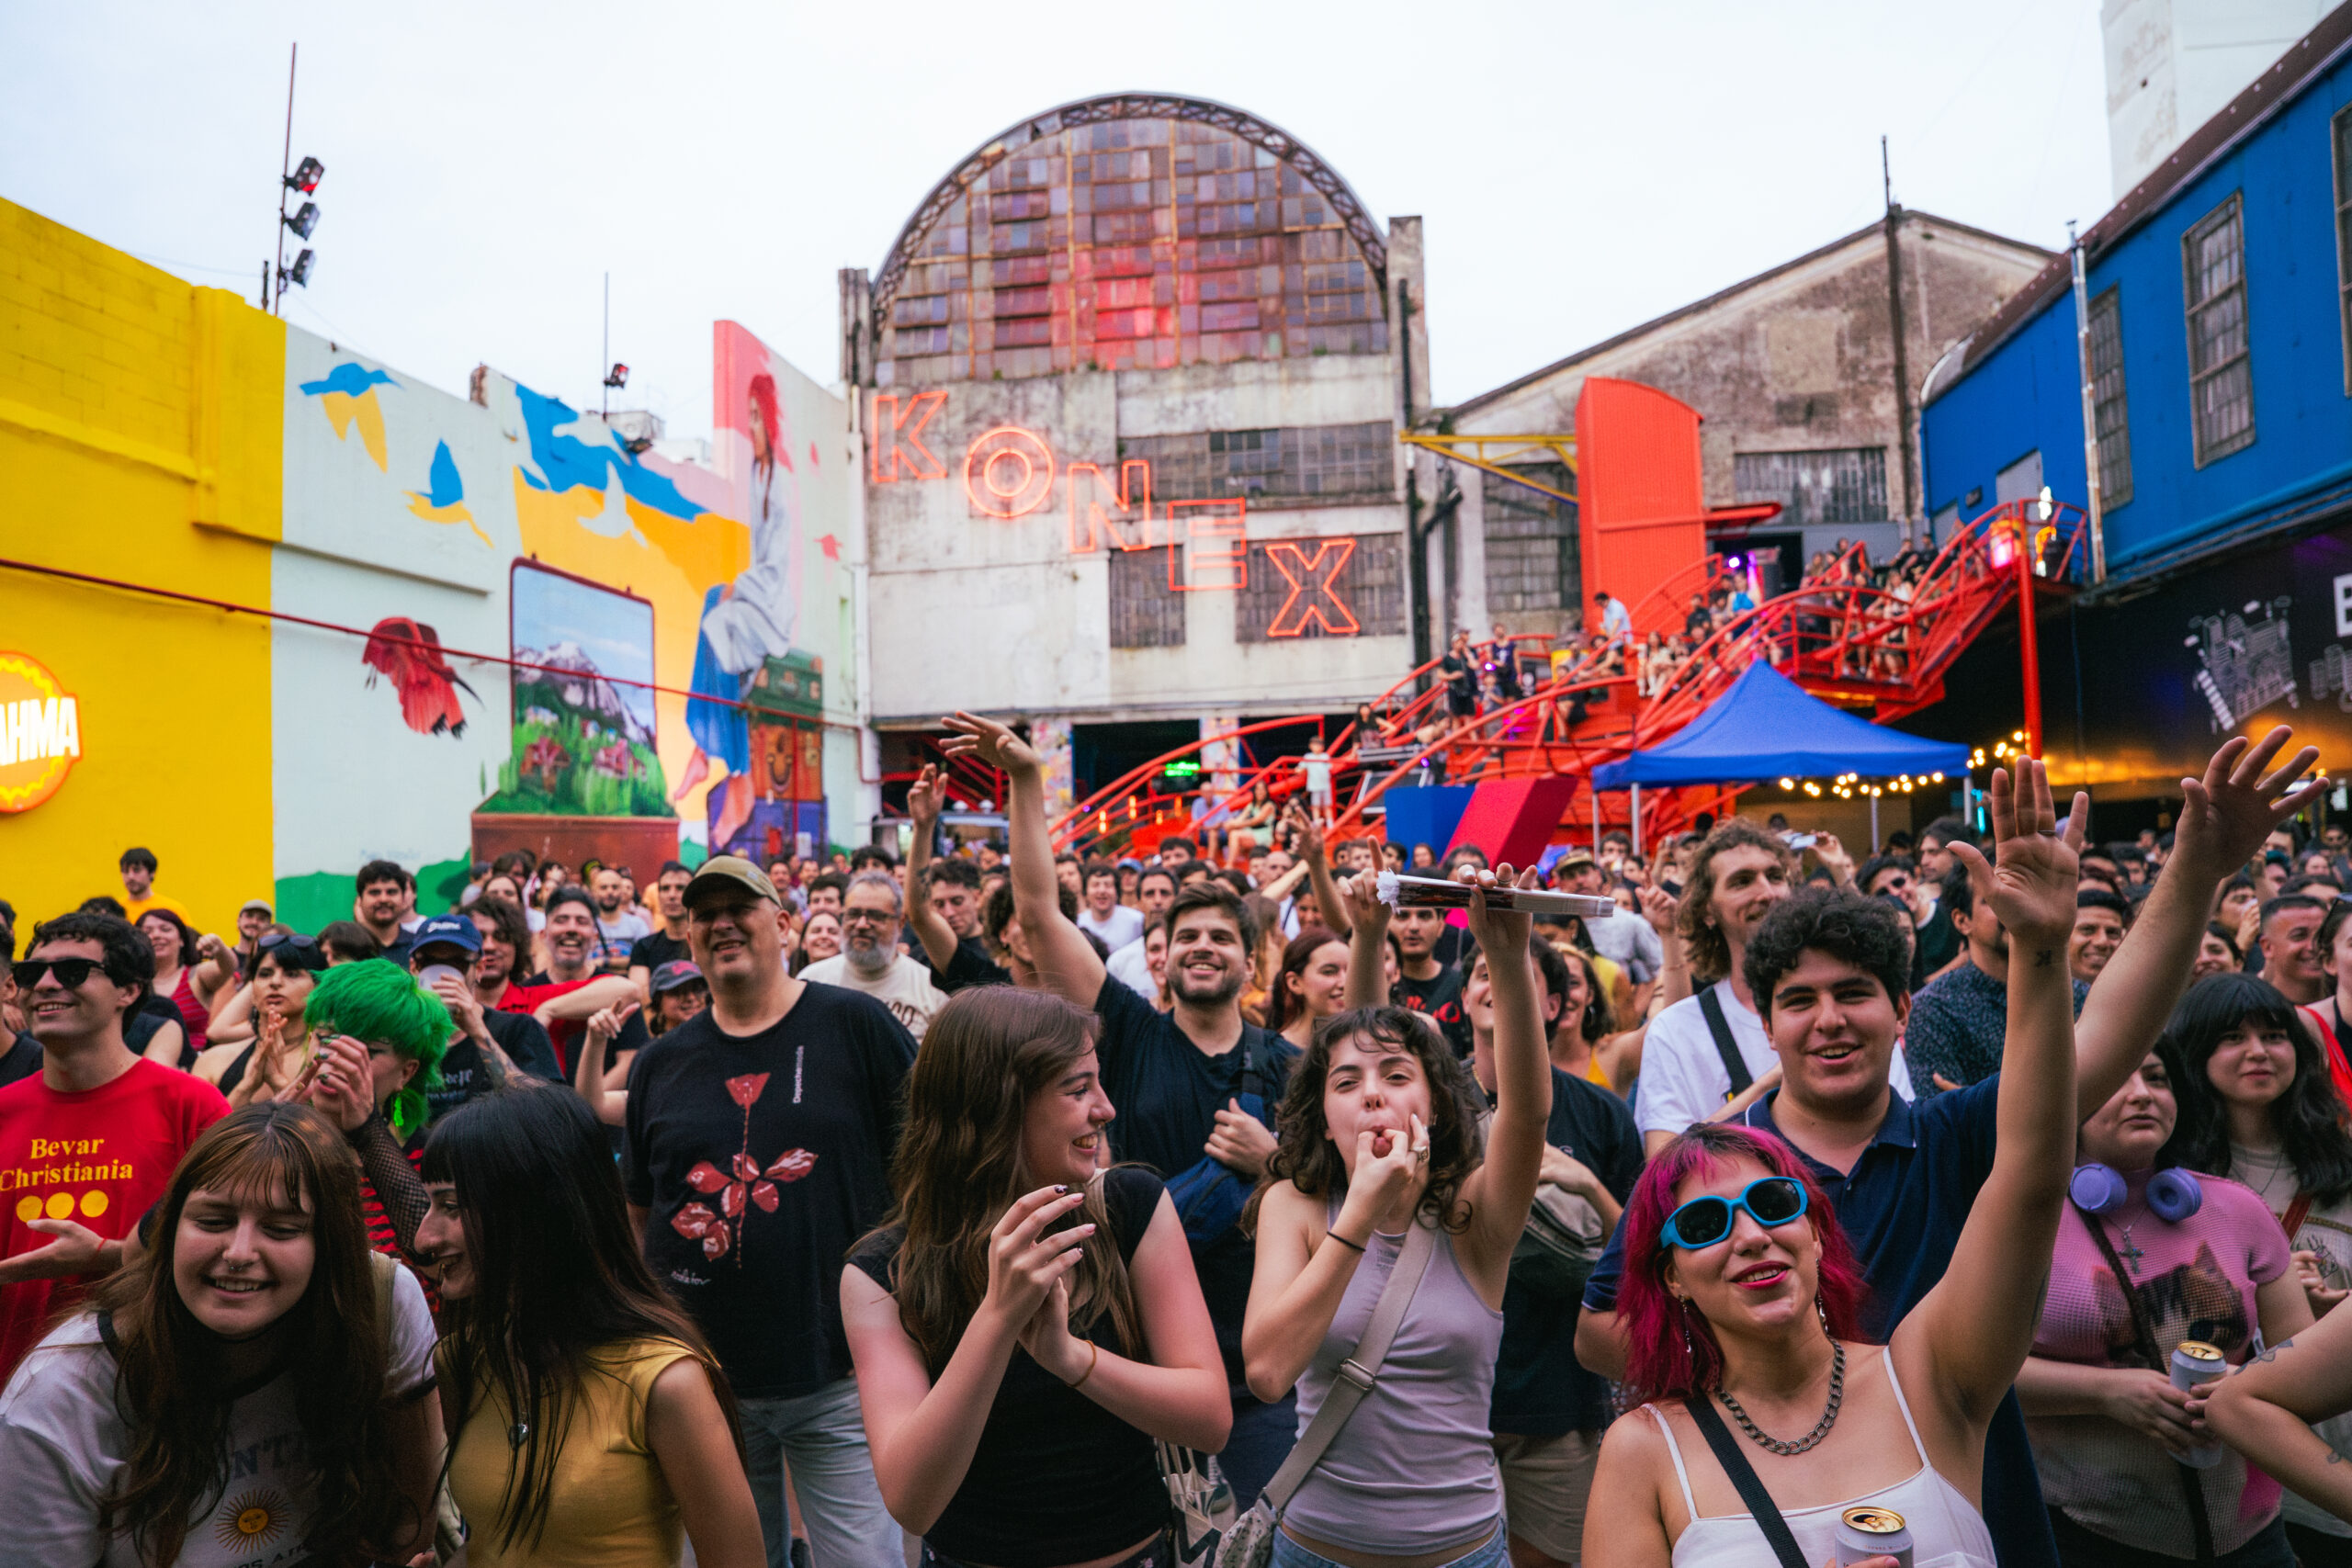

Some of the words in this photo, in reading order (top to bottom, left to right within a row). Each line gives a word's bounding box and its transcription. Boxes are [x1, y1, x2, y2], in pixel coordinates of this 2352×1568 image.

[872, 390, 1361, 637] KONEX
[29, 1138, 105, 1159] Bevar
[0, 1159, 133, 1191] Christiania
